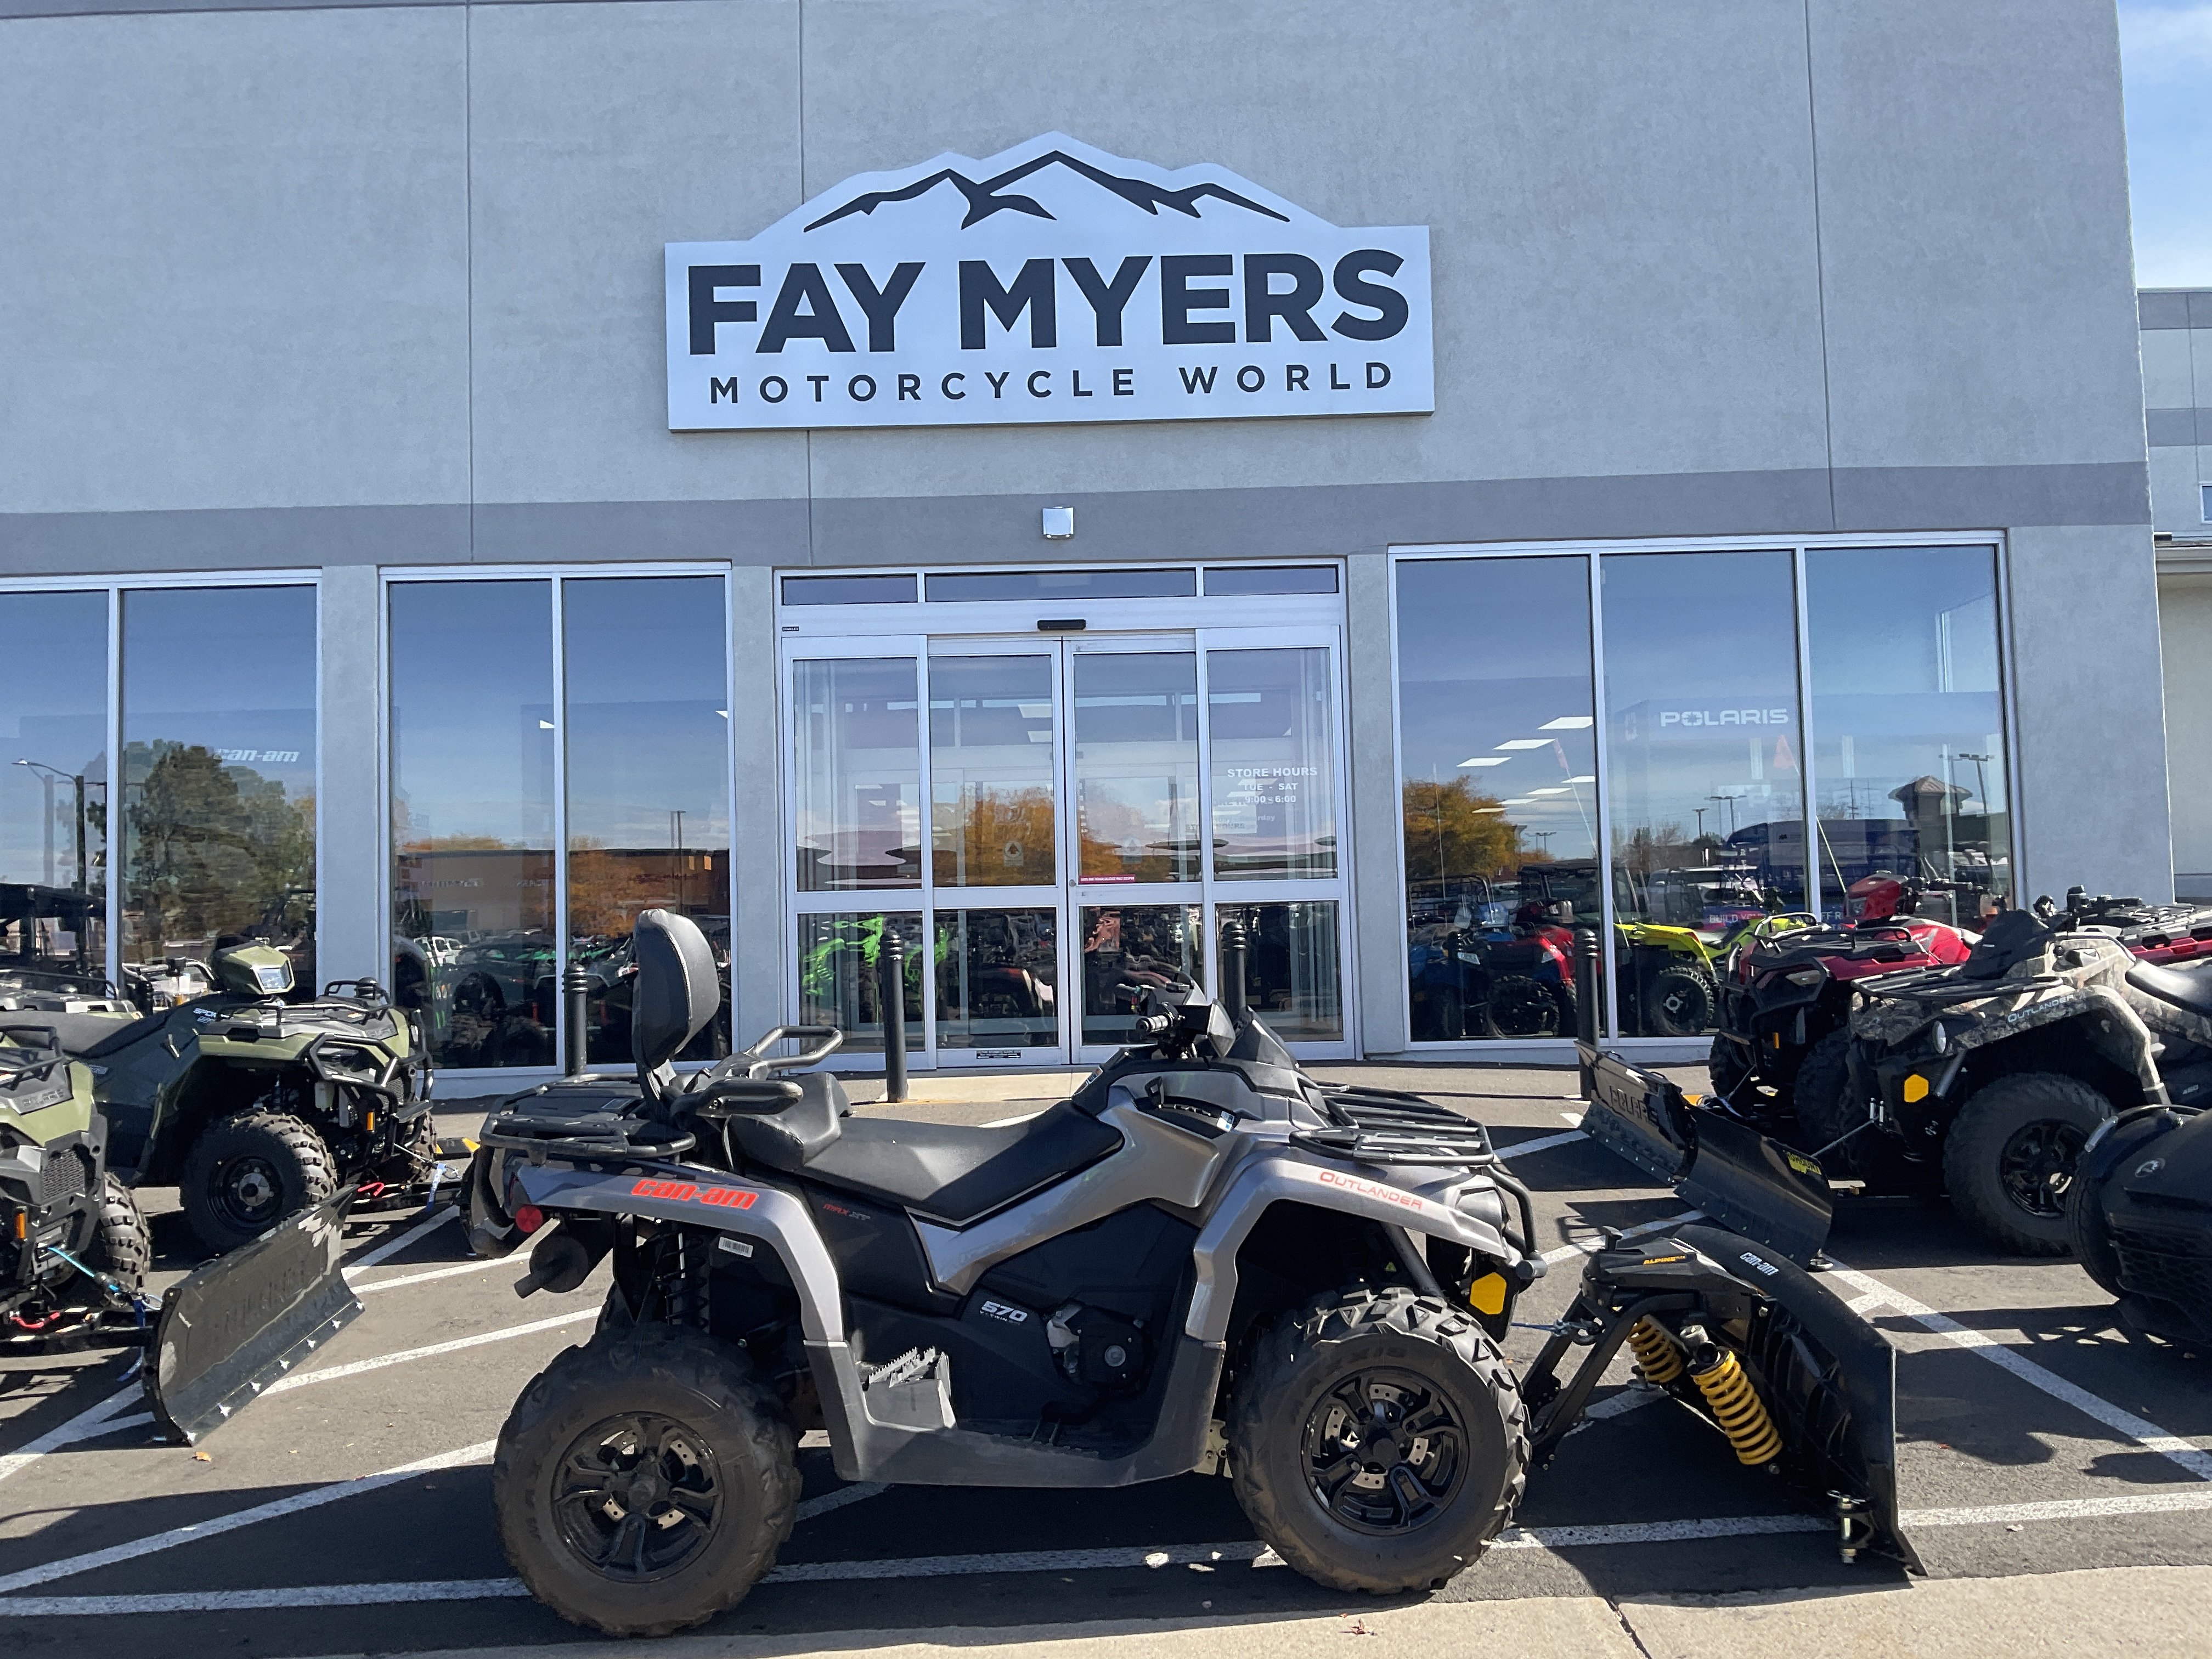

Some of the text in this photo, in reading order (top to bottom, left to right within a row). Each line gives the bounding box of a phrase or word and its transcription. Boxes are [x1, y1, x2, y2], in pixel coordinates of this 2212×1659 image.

[688, 249, 1409, 356] FAY MYERS
[710, 362, 1391, 404] MOTORCYCLE WORLD
[1660, 708, 1788, 727] POLARIS
[213, 748, 300, 762] can-am
[1227, 768, 1317, 777] STORE HOURS
[631, 1179, 758, 1210] can-am
[1739, 1252, 1779, 1276] can-am
[981, 1300, 1028, 1322] 570
